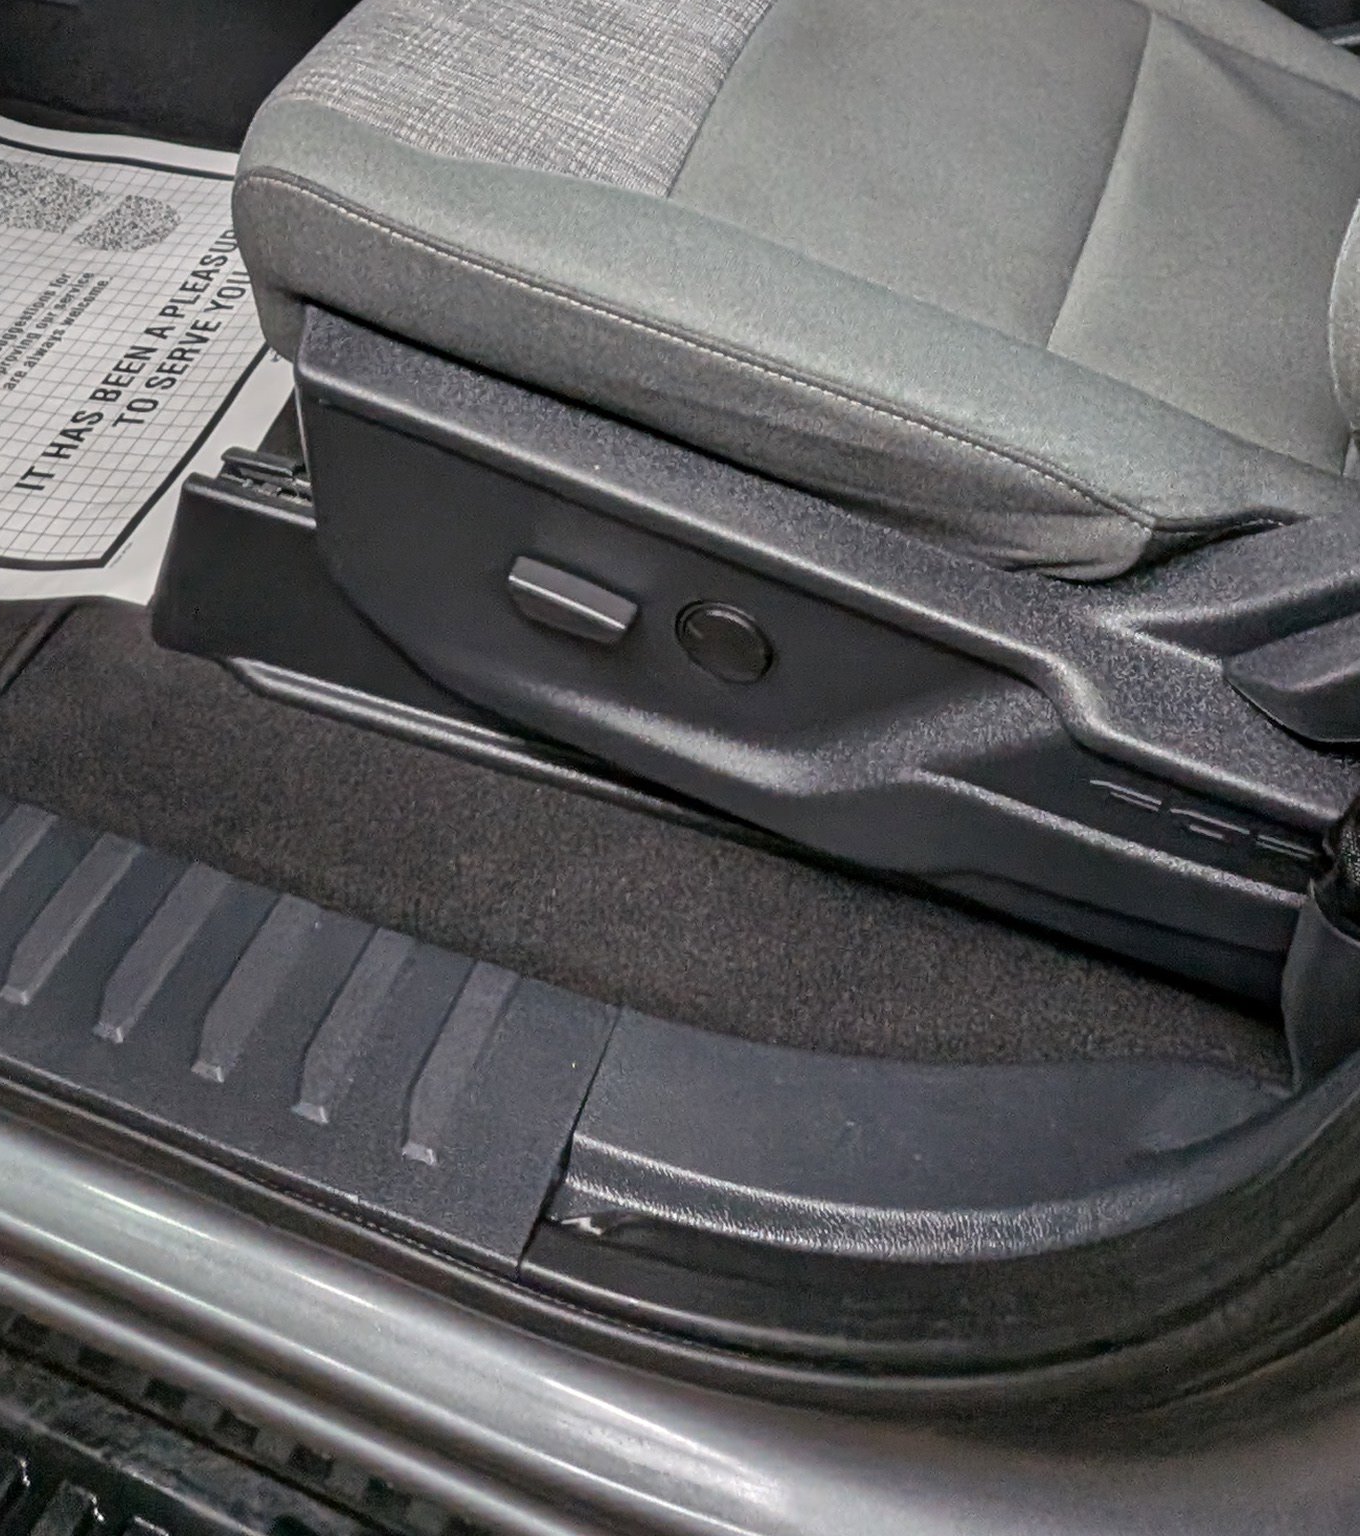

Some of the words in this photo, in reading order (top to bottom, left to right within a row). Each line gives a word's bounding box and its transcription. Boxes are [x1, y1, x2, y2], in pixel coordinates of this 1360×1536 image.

[35, 311, 58, 329] our
[53, 272, 95, 310] service
[48, 272, 71, 288] for
[158, 229, 239, 318] PLEASU
[2, 370, 28, 391] are
[23, 328, 66, 368] always
[111, 398, 159, 427] TO
[144, 319, 222, 390] SERVE
[202, 271, 251, 312] YOU
[143, 326, 176, 340] A
[88, 345, 158, 402] BEEN
[40, 410, 104, 460] HAS
[13, 465, 55, 491] IT
